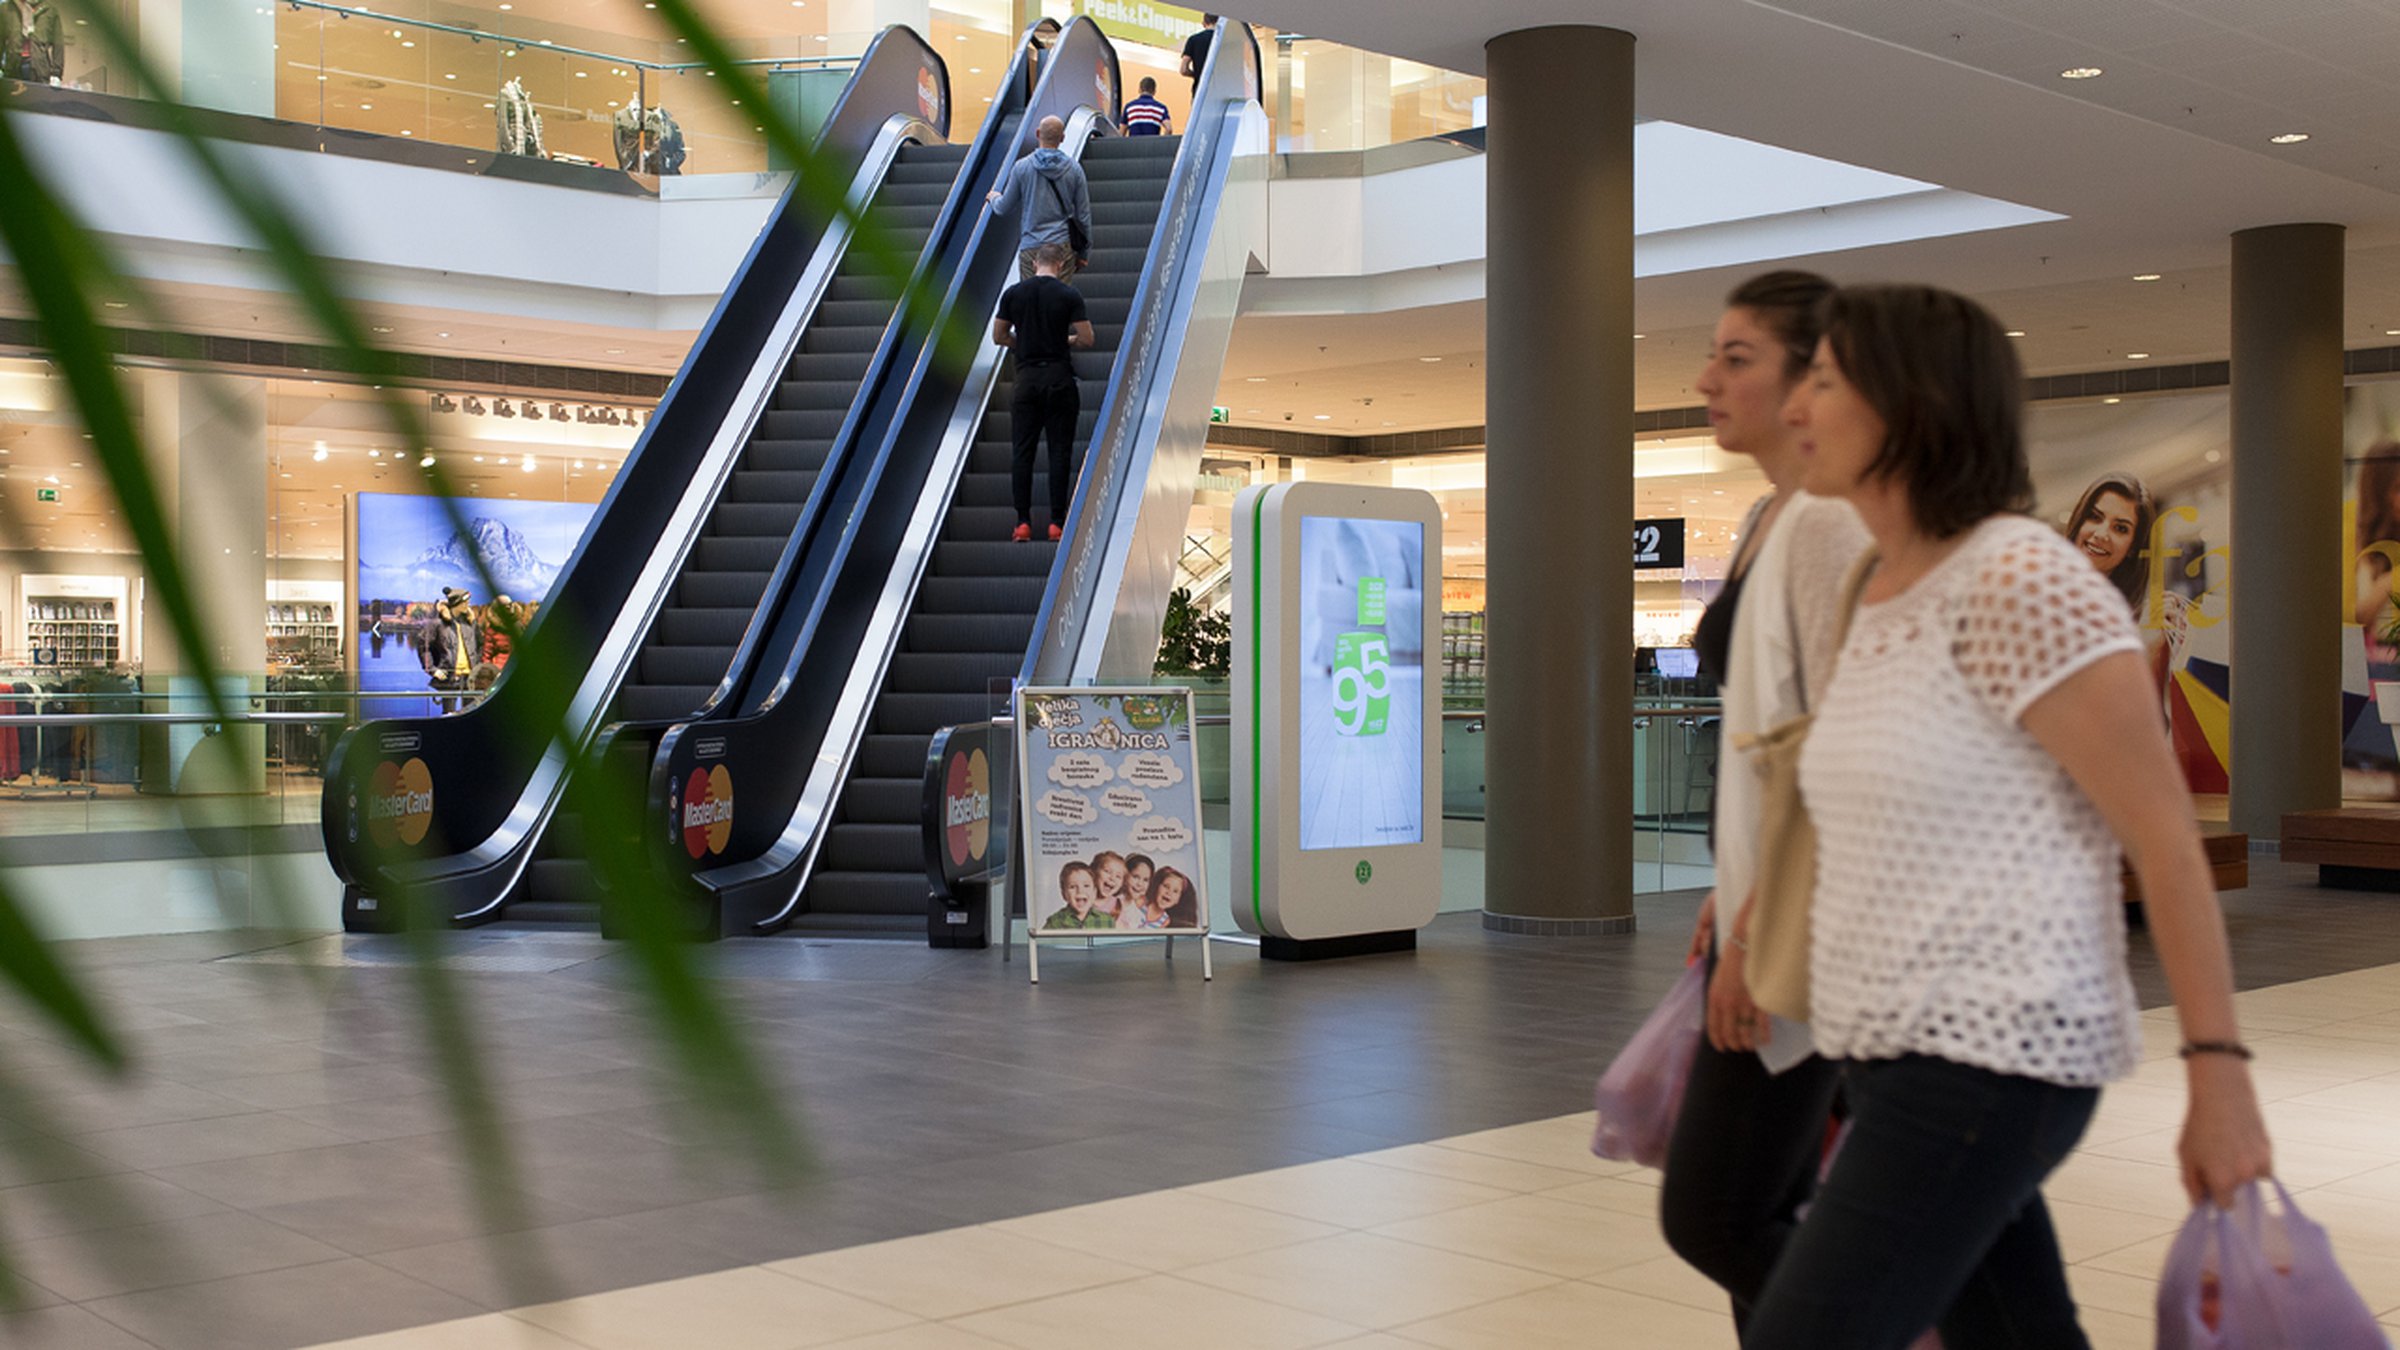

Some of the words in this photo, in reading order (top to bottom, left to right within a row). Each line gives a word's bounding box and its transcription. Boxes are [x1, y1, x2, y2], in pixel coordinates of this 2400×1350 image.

[1634, 525, 1661, 563] 2
[1332, 639, 1391, 736] 95
[1034, 699, 1080, 713] Velika
[1038, 711, 1082, 729] dječja
[368, 788, 432, 820] MasterCard
[683, 795, 734, 828] MasterCard
[946, 787, 989, 828] MasterCard
